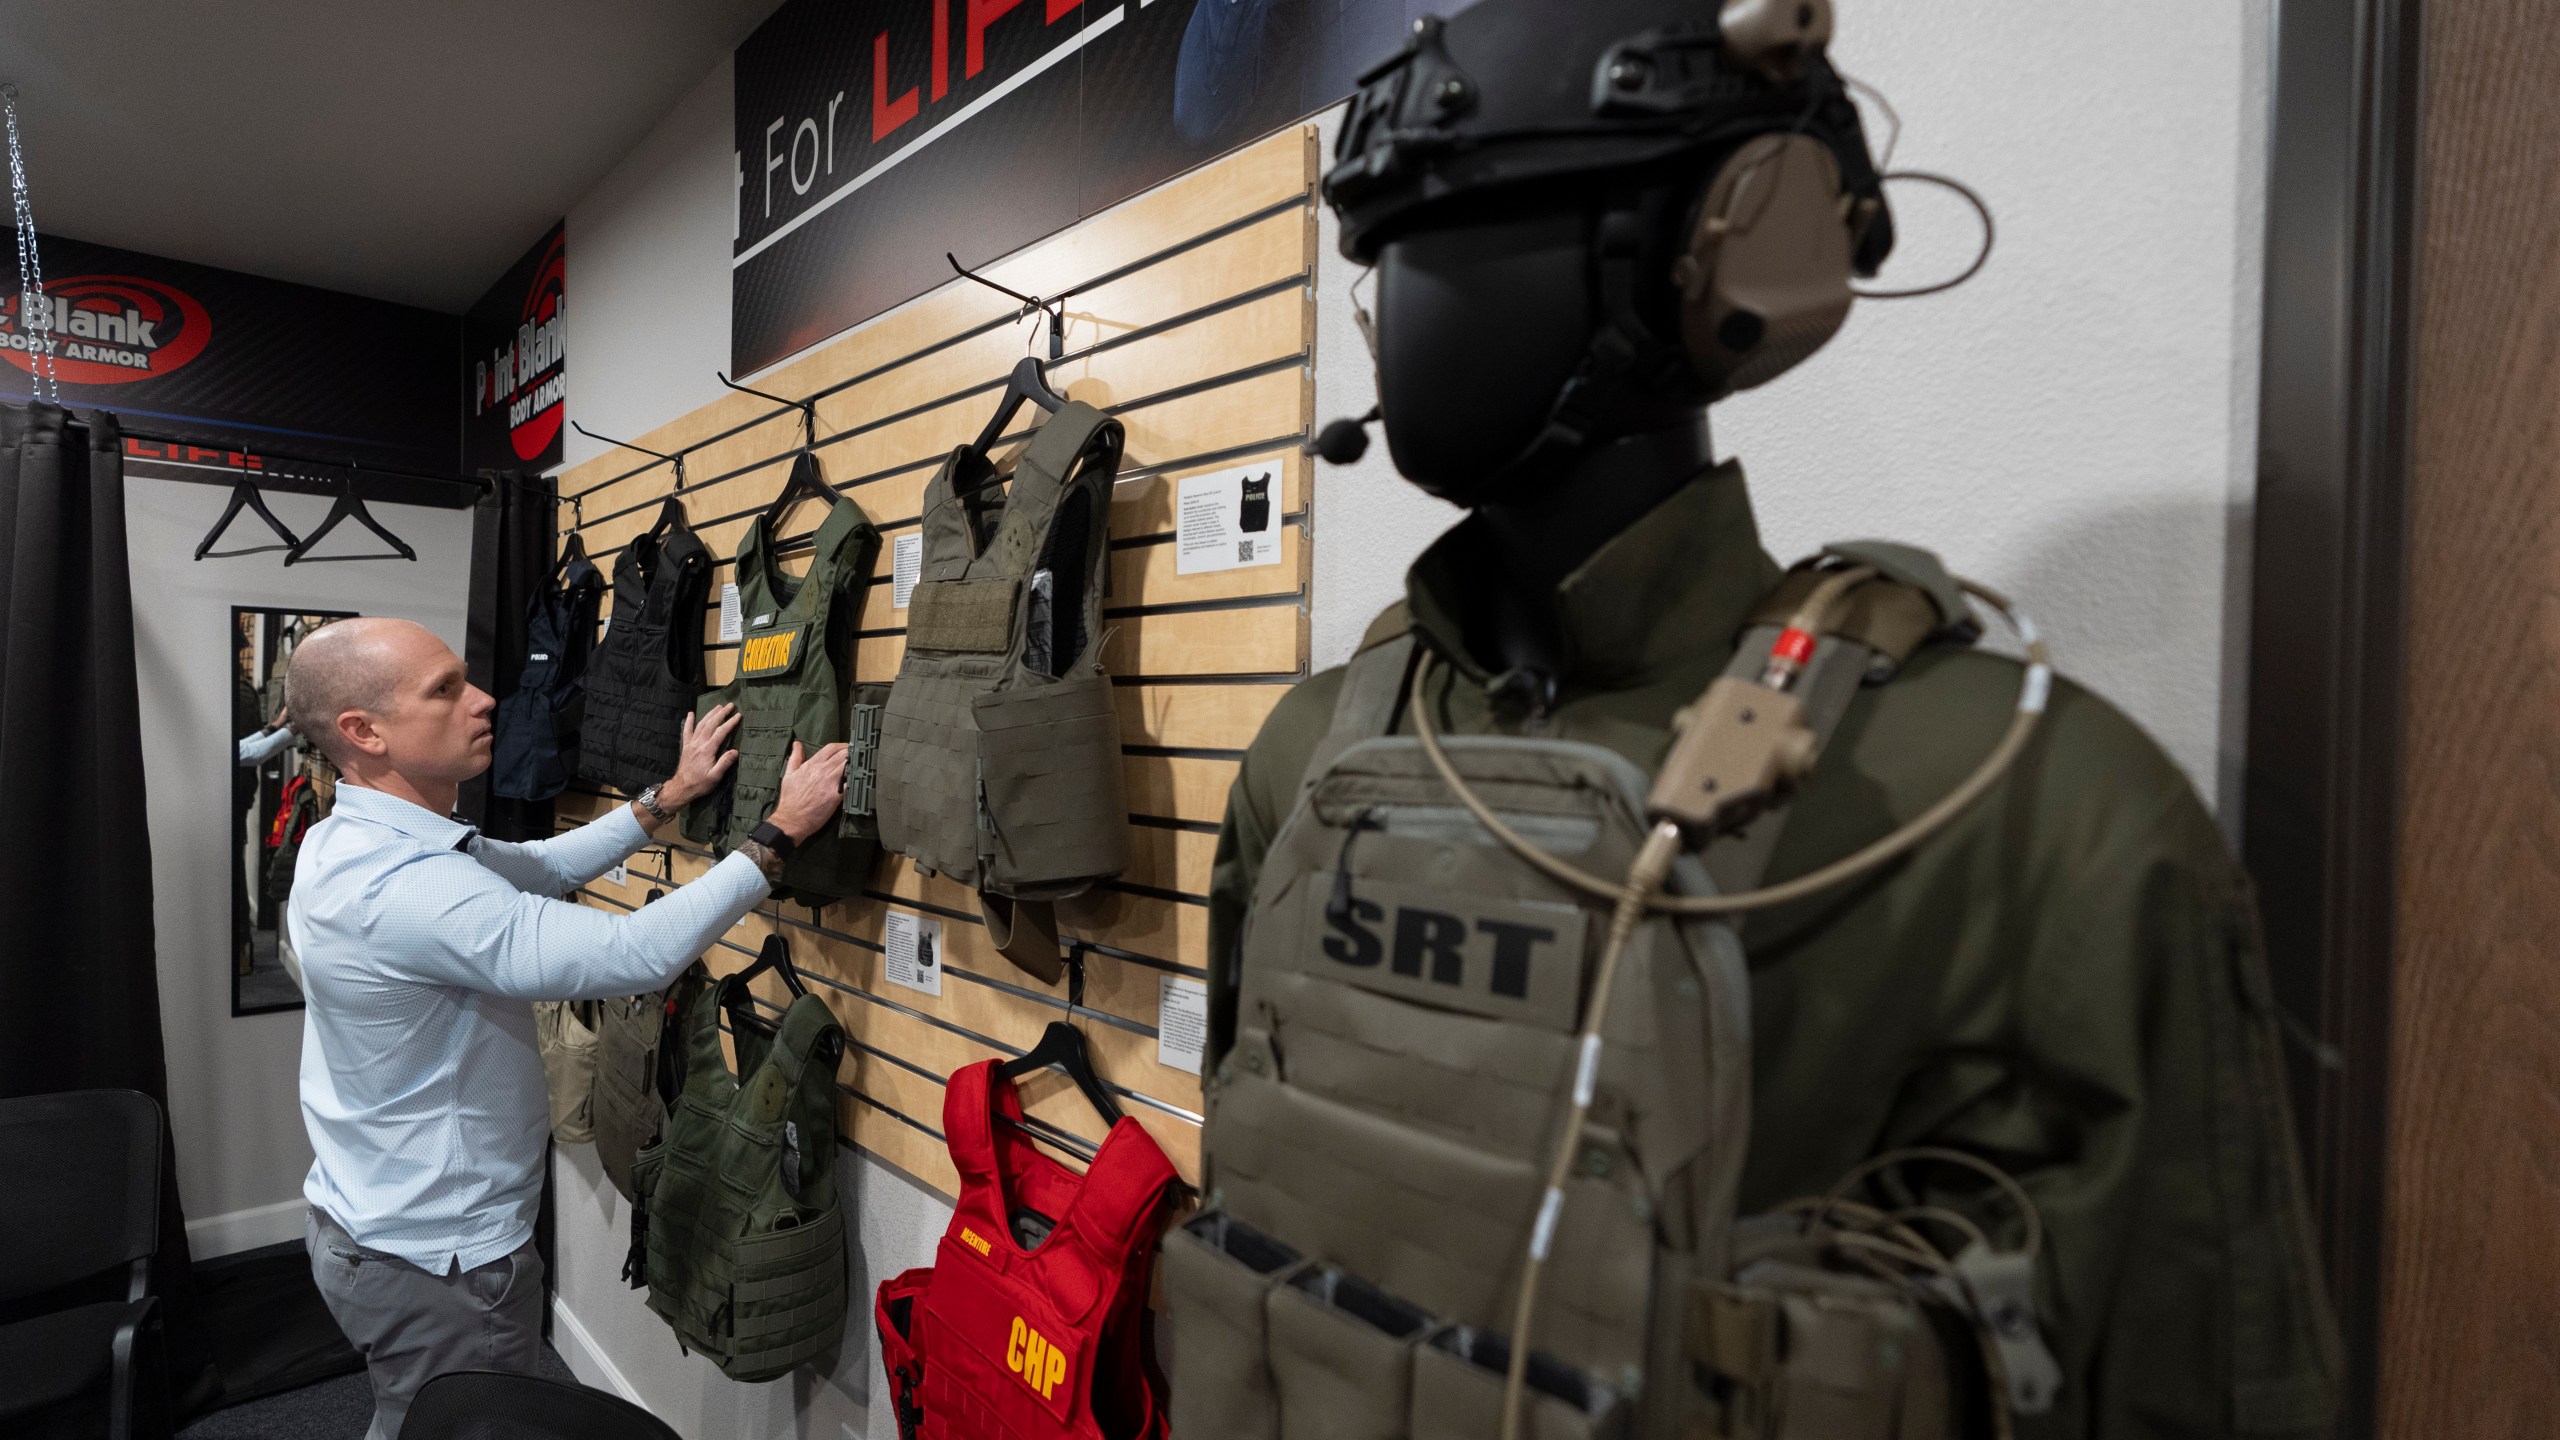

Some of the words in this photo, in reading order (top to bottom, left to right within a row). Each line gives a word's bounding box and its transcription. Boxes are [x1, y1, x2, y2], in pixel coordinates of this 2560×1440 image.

[765, 90, 844, 219] For
[872, 0, 1083, 145] LIF
[20, 290, 158, 349] Blank
[65, 343, 149, 369] ARMOR
[476, 339, 517, 417] Point
[510, 393, 533, 430] BODY
[533, 372, 565, 416] ARMOR
[1322, 896, 1557, 999] SRT
[1007, 1315, 1067, 1401] CHP
